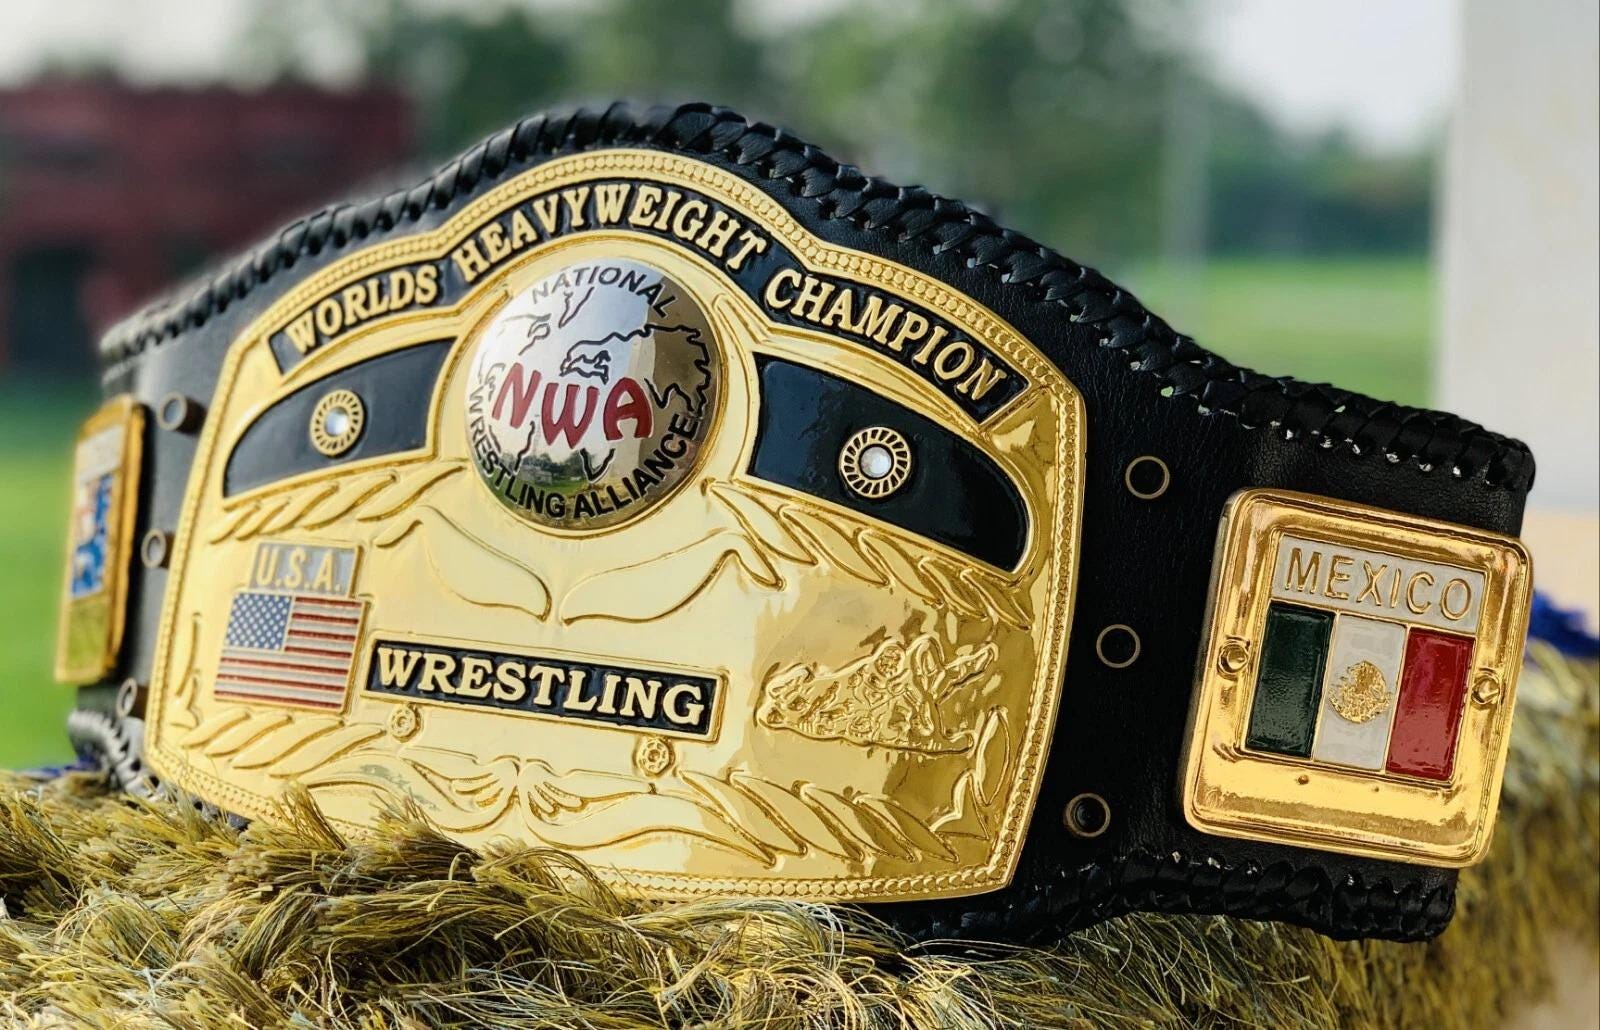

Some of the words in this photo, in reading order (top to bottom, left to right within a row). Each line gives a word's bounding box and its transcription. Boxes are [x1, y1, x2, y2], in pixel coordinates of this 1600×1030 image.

[284, 265, 438, 355] WORLDS
[451, 184, 767, 283] HEAVYWEIGHT
[765, 269, 1008, 401] CHAMPION
[532, 266, 677, 318] NATIONAL
[492, 362, 653, 449] NWA
[469, 387, 565, 519] WRESTLING
[573, 413, 697, 518] ALLIANCE
[256, 546, 343, 591] U.S.A.
[1284, 547, 1472, 620] MEXICO
[377, 646, 704, 726] WRESTLING
